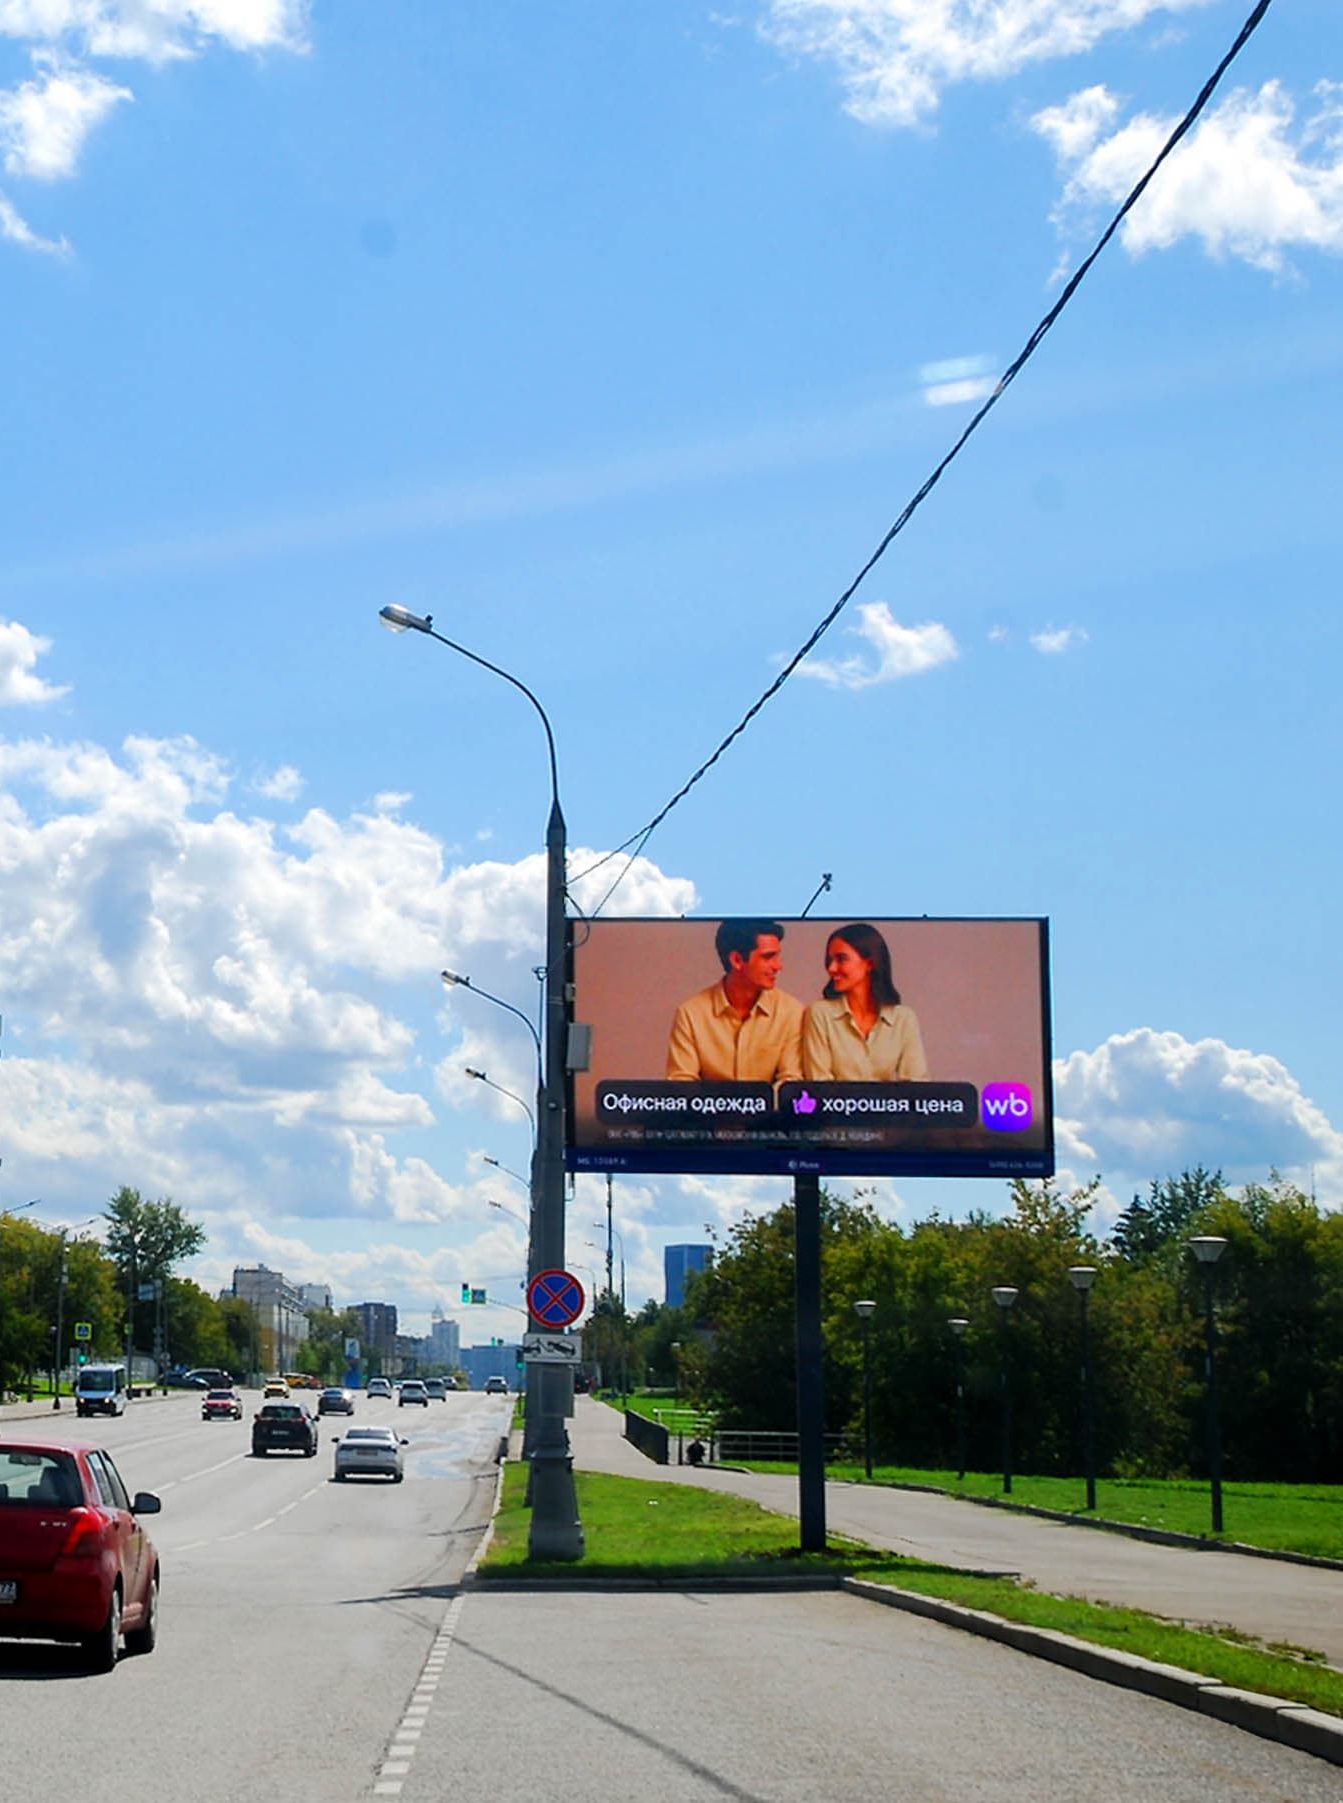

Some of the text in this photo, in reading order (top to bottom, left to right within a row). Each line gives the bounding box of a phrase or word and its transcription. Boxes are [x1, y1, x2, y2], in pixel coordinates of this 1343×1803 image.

[603, 1093, 765, 1114] Офисная одежда
[822, 1098, 964, 1115] хорошая цена
[985, 1092, 1028, 1116] wb
